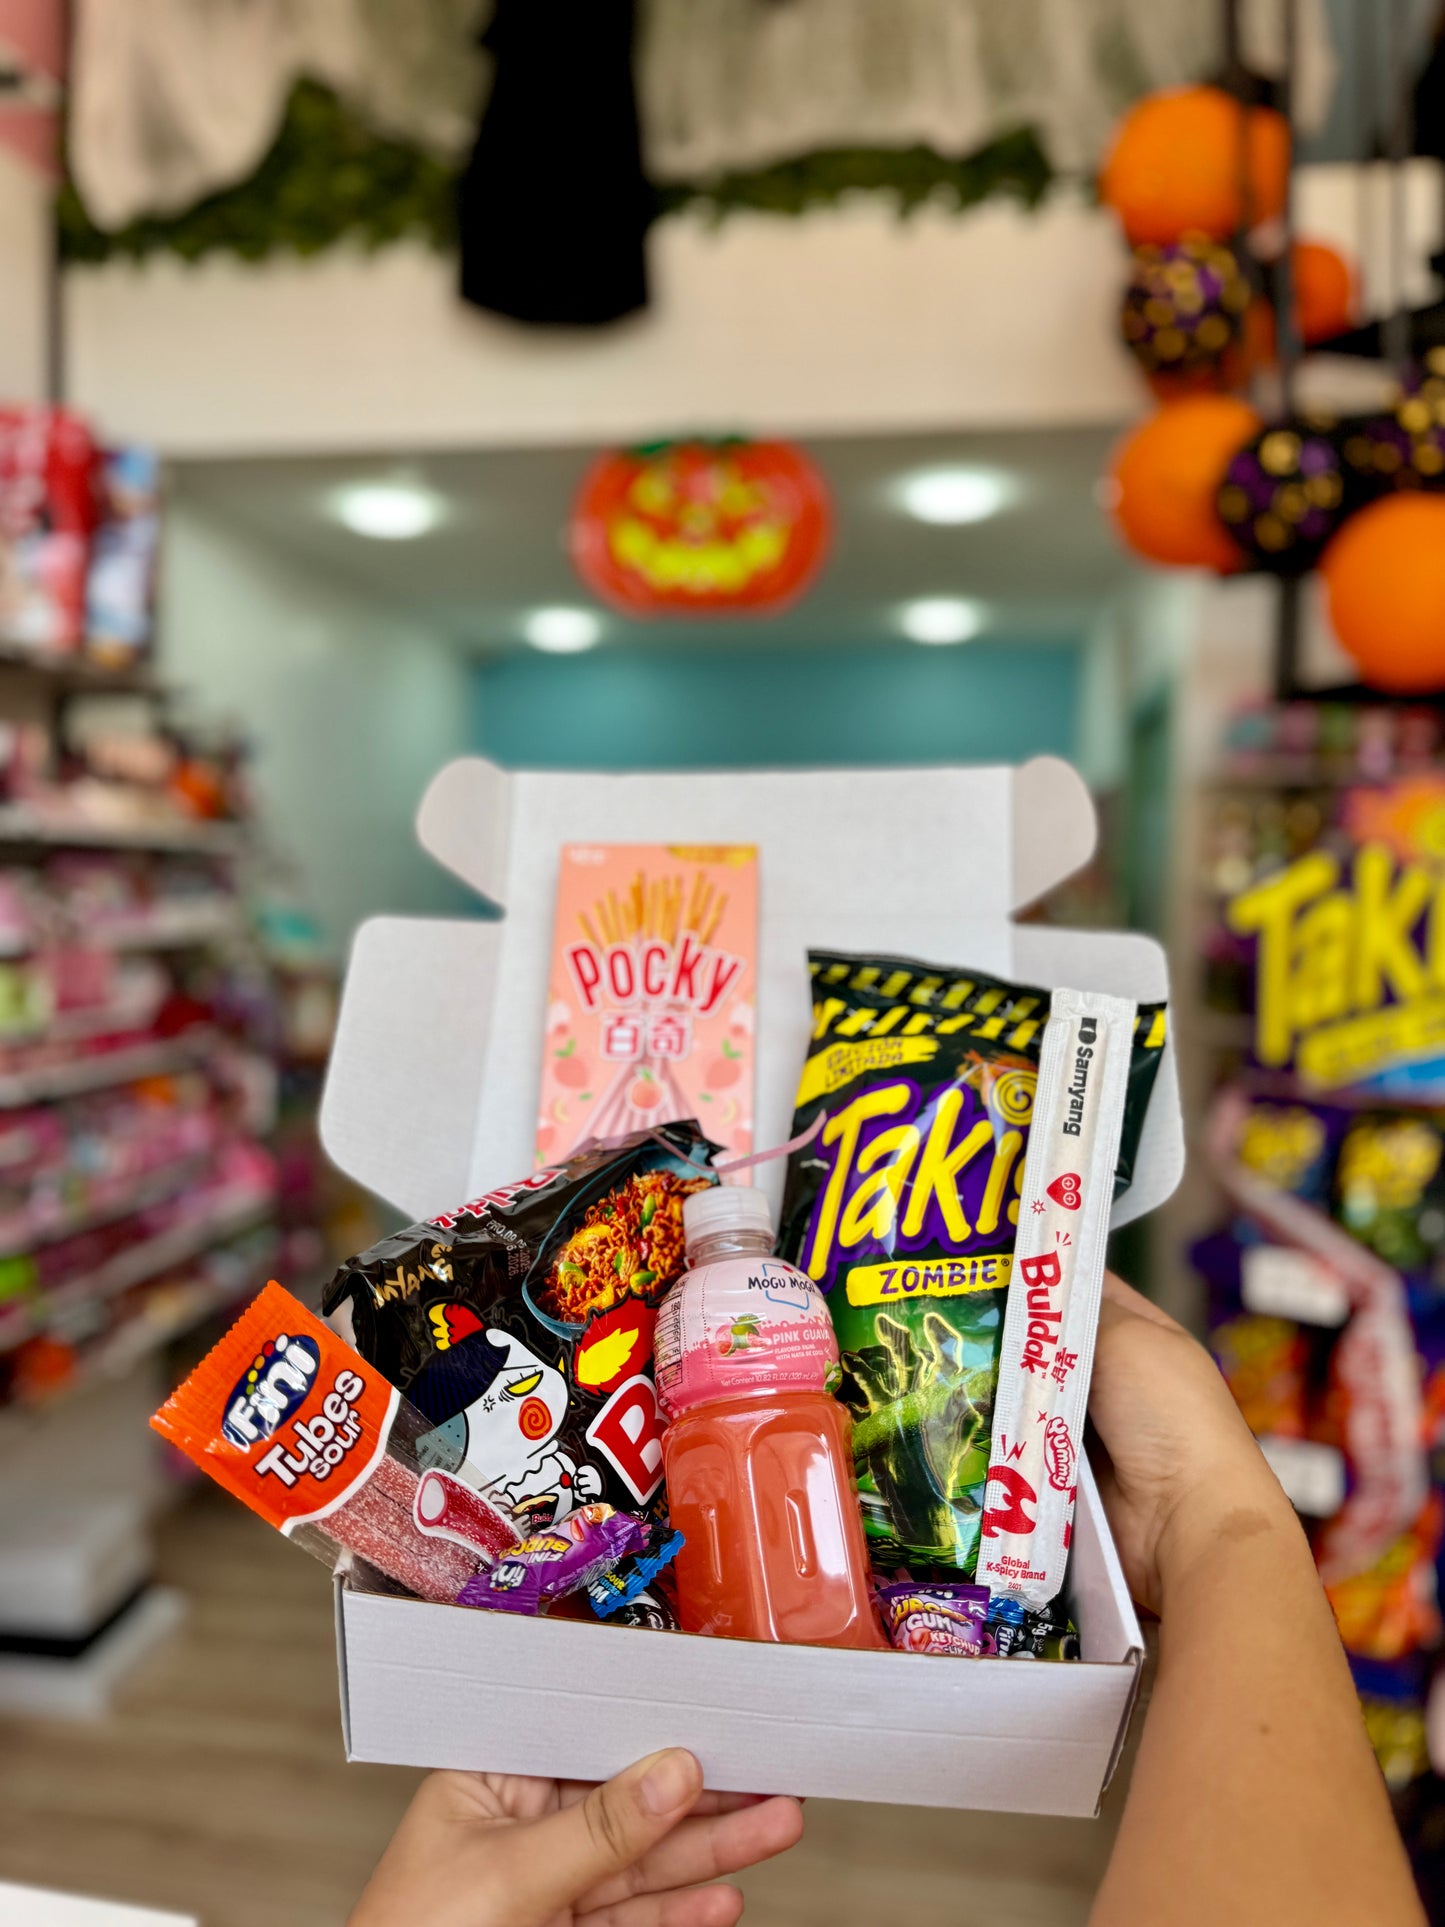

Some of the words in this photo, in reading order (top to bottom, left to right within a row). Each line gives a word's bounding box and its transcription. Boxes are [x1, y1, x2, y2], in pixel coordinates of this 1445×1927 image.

[603, 1012, 688, 1057] 百奇
[878, 1257, 998, 1296] ZOMBIE
[1019, 1250, 1063, 1374] Buldak
[772, 1330, 799, 1346] PINK
[802, 1327, 831, 1342] GUAVA
[255, 1370, 365, 1487] Tubes
[309, 1411, 362, 1480] sour
[1045, 1416, 1071, 1491] Yummy
[986, 1562, 1020, 1580] K-Spicy
[1020, 1568, 1046, 1582] Brand
[1001, 1555, 1031, 1570] Global
[906, 1612, 953, 1633] GUM
[929, 1630, 981, 1656] KETCHUP
